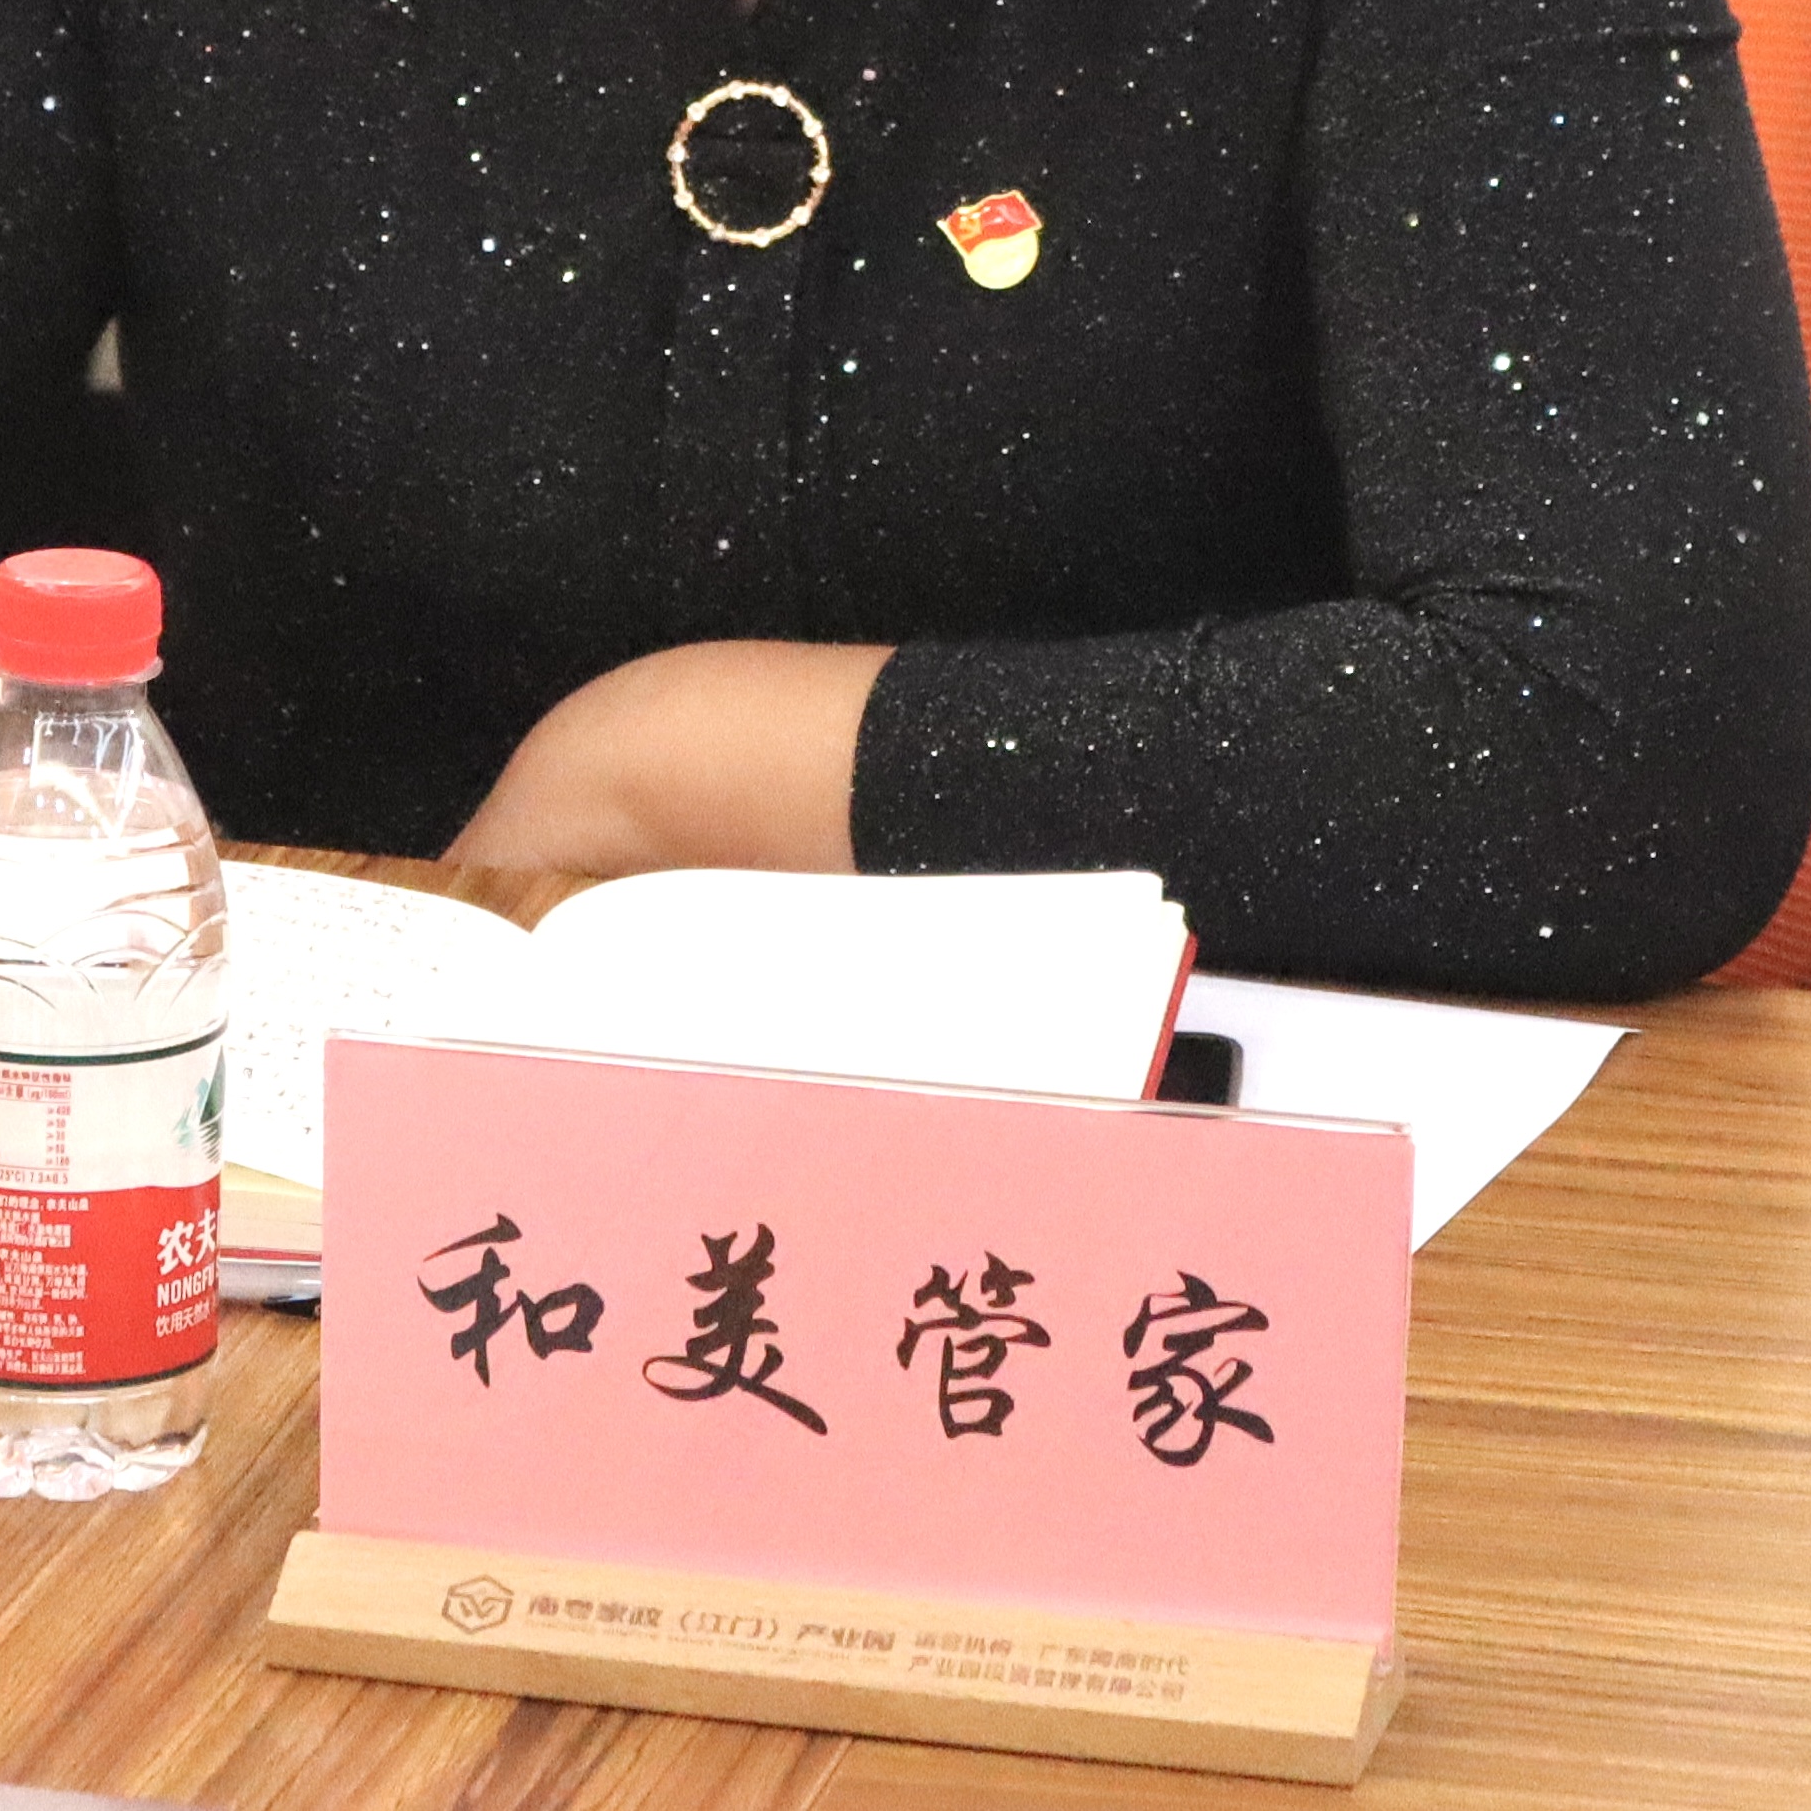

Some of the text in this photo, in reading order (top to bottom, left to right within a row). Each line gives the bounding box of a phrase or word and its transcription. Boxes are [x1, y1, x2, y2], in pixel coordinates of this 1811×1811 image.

[156, 1208, 216, 1276] 农夫
[417, 1211, 1275, 1469] 和美管家
